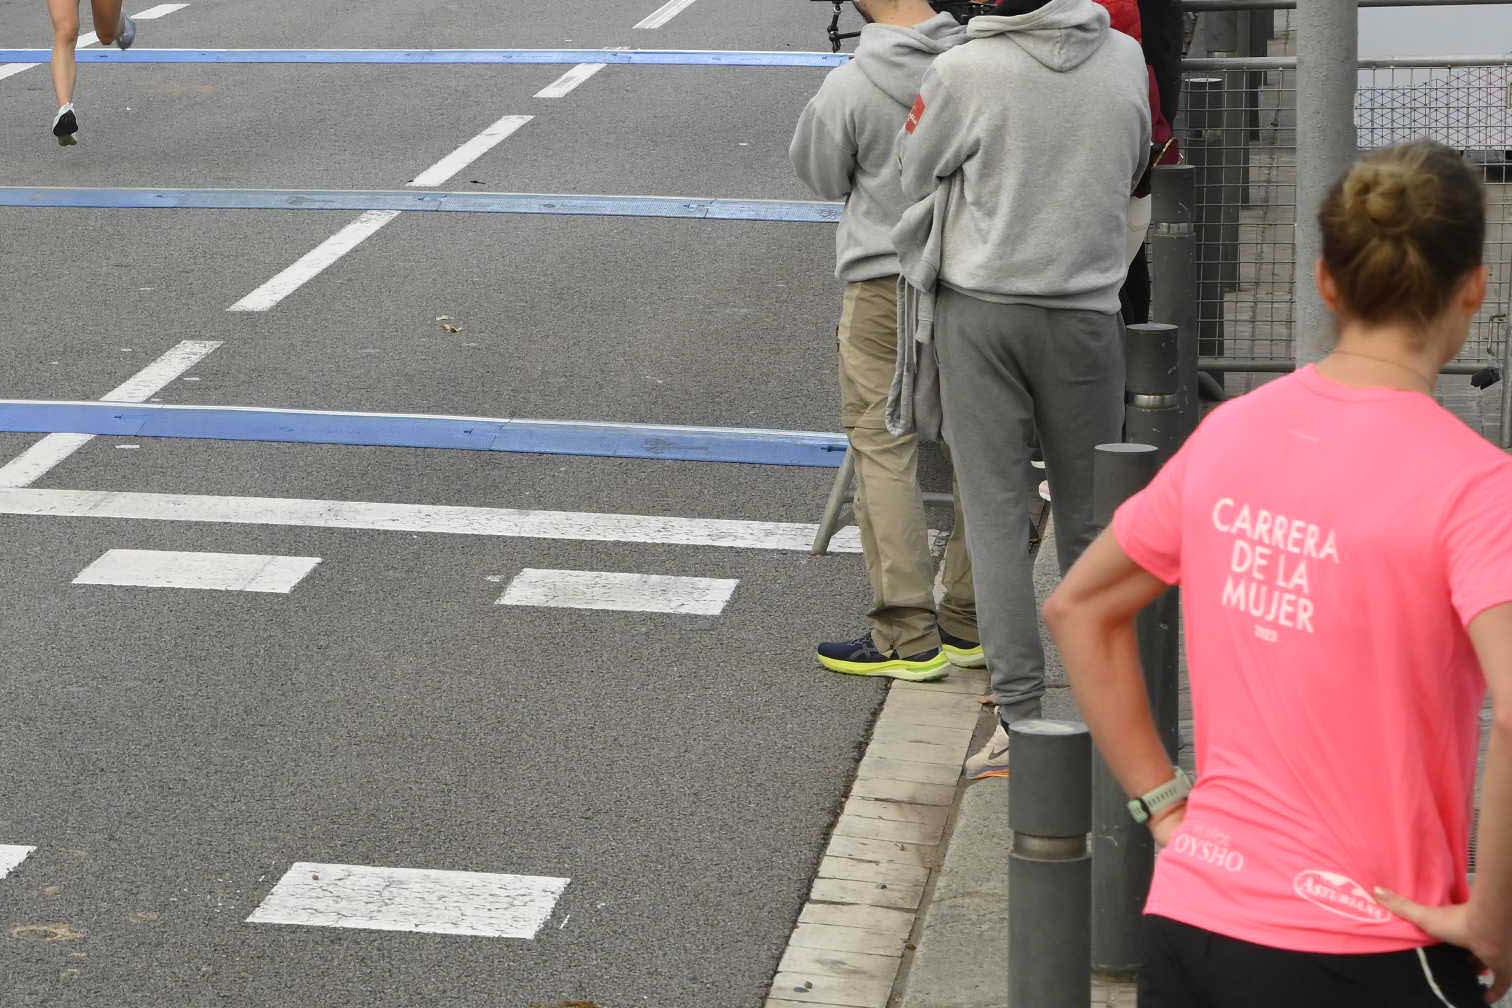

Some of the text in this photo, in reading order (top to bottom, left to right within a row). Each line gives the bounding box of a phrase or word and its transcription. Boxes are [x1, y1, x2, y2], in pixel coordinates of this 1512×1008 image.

[1213, 497, 1340, 564] CARRERA
[1232, 539, 1310, 592] DE LA
[1222, 576, 1315, 633] MUJER
[1175, 832, 1244, 872] OYSHO
